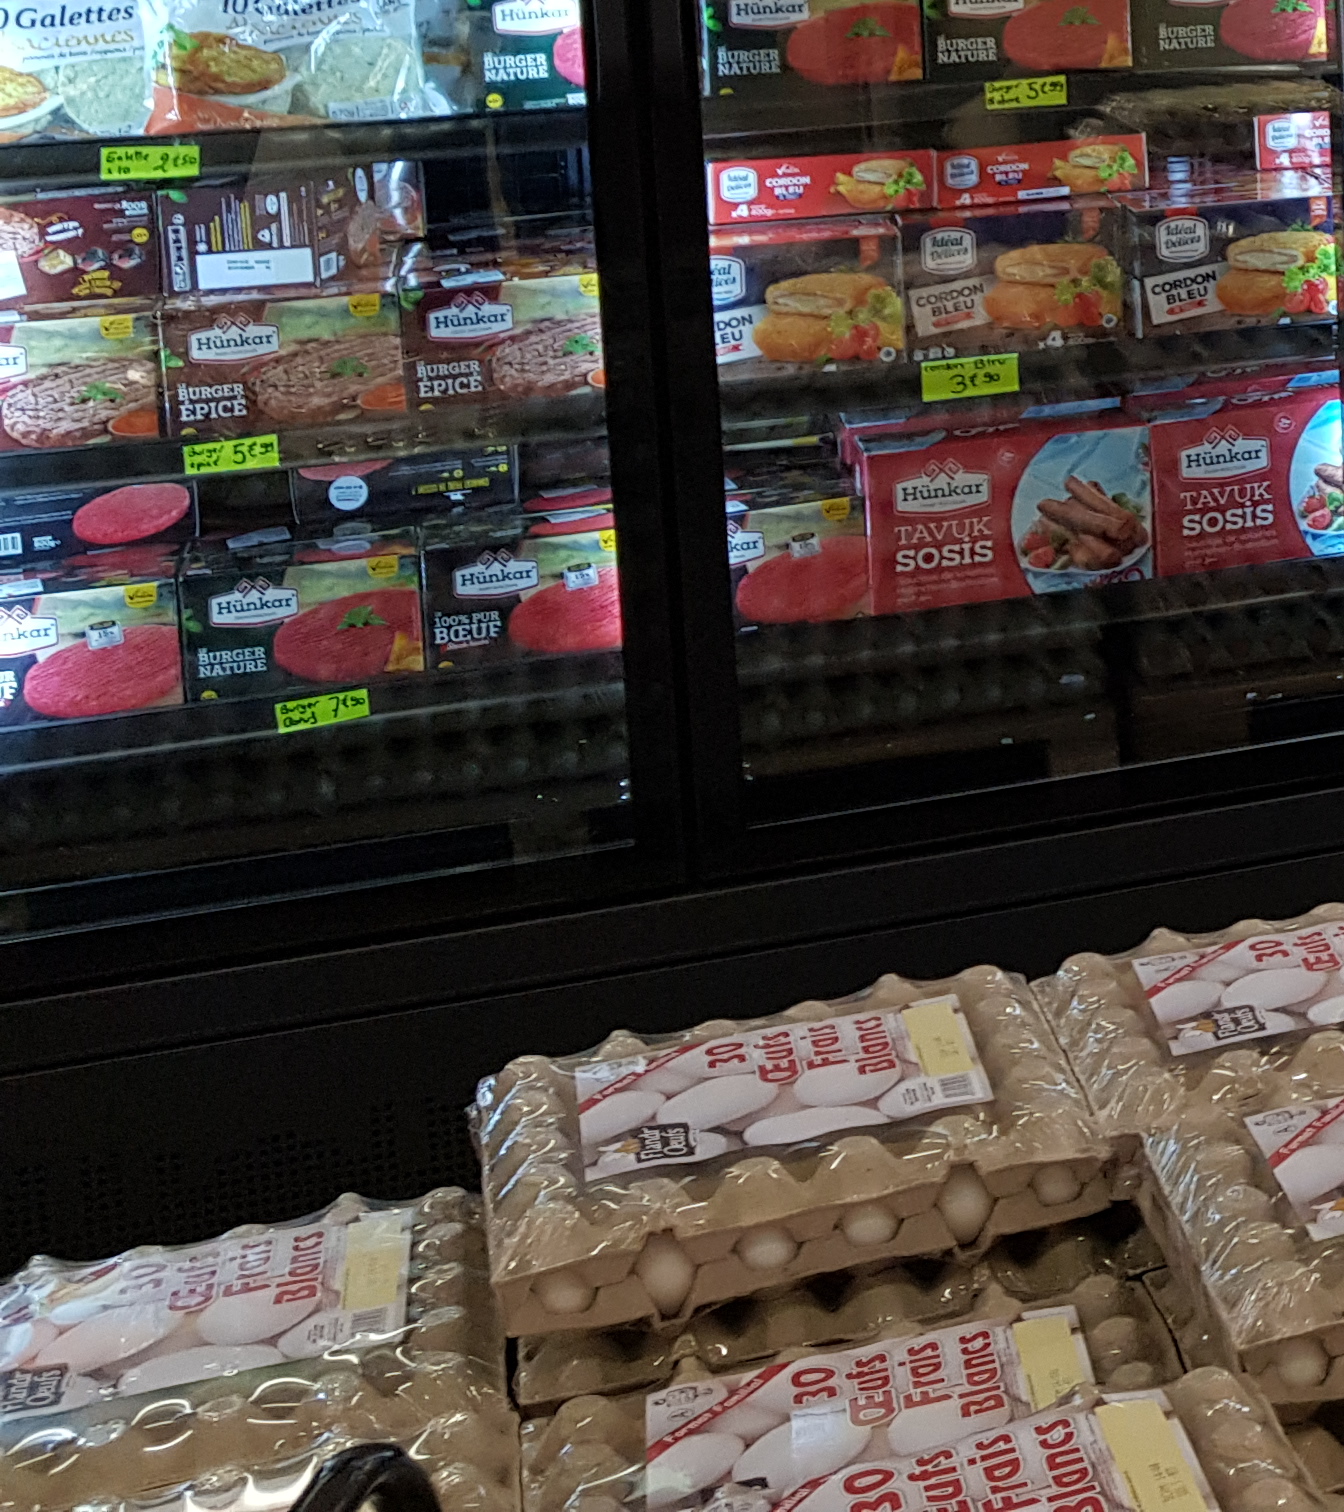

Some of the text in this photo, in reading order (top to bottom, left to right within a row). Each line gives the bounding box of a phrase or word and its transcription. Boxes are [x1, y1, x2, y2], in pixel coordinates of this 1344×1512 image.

[15, 2, 136, 30] Galettes
[717, 49, 782, 65] BURGER
[936, 37, 998, 53] BURGER
[483, 52, 548, 70] BURGER
[484, 65, 549, 83] NATURE
[765, 175, 812, 190] CORDON
[1151, 271, 1219, 297] CORDON
[1165, 283, 1212, 304] BLEU
[914, 284, 985, 309] CORDON
[930, 298, 976, 317] BLEU
[432, 307, 509, 331] Hünkar
[195, 329, 275, 355] Hünkar
[416, 359, 482, 380] BURGER
[177, 383, 245, 404] BURGER
[1185, 446, 1264, 470] Hünkar
[901, 480, 985, 504] Hünkar
[1180, 483, 1273, 511] TAVUK
[893, 516, 994, 546] TAVUK
[895, 539, 995, 574] SOSİS
[459, 566, 536, 589] Hünkar
[215, 593, 296, 617] Hünkar
[433, 611, 501, 631] 100% PUR
[434, 623, 502, 646] BŒUF
[198, 648, 268, 666] BURGER
[198, 659, 268, 679] NATURE
[1248, 939, 1291, 963] 30
[1296, 930, 1342, 972] Œufs
[704, 1041, 749, 1069] 30
[752, 1030, 799, 1084] Œufs
[800, 1023, 852, 1071] Frais
[853, 1015, 897, 1076] Blancs
[221, 1239, 275, 1299] Frais
[272, 1230, 326, 1305] Blancs
[897, 1338, 952, 1410] Frais
[958, 1328, 1004, 1419] Blancs
[792, 1366, 839, 1406] 30
[844, 1349, 898, 1428] Œufs
